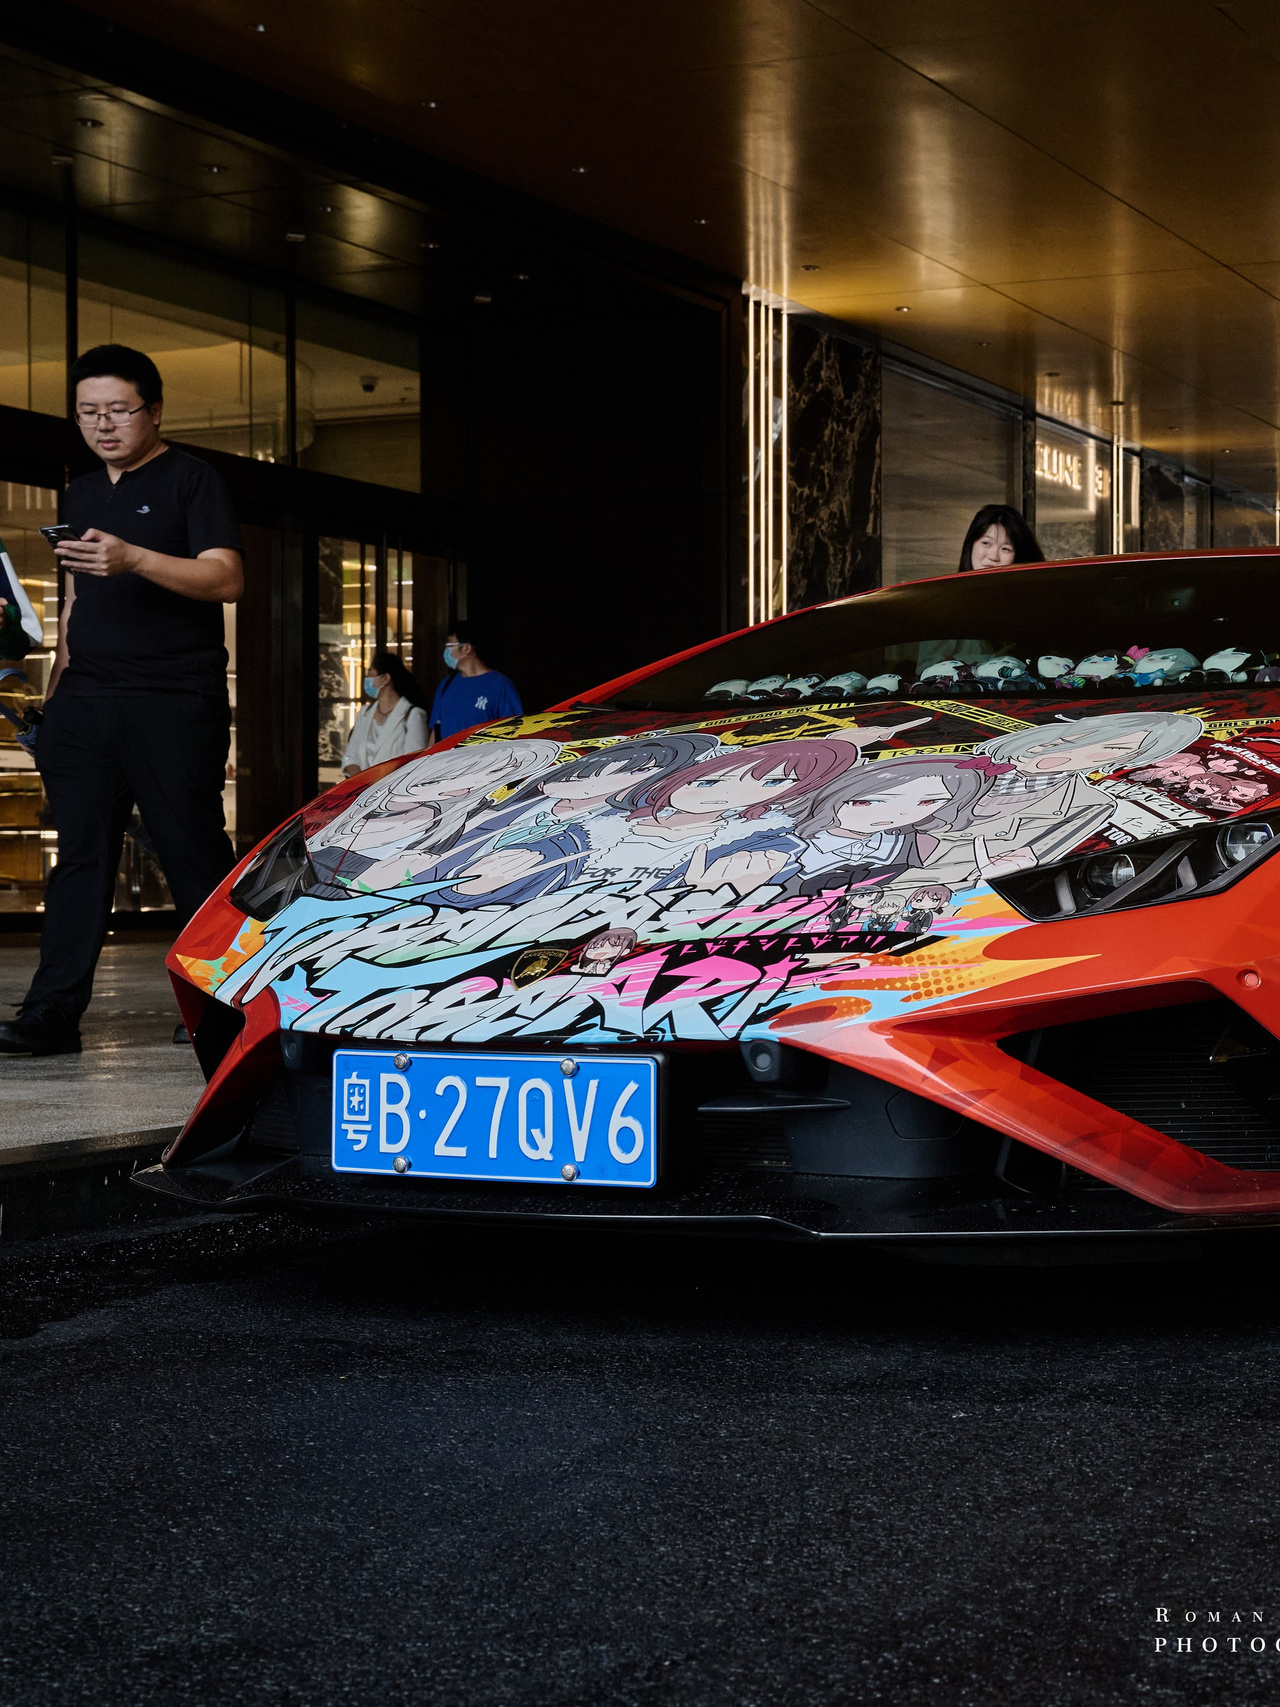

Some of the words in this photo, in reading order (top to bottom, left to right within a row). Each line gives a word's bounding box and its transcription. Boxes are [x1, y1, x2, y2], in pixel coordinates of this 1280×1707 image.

[747, 710, 783, 720] BAND
[1208, 720, 1250, 729] GIRLS
[1102, 826, 1136, 847] TOG
[573, 866, 624, 882] FOR
[629, 866, 673, 880] THE
[679, 934, 888, 957] トゲナシトゲアリ
[341, 1071, 645, 1165] 粤B·27QV6
